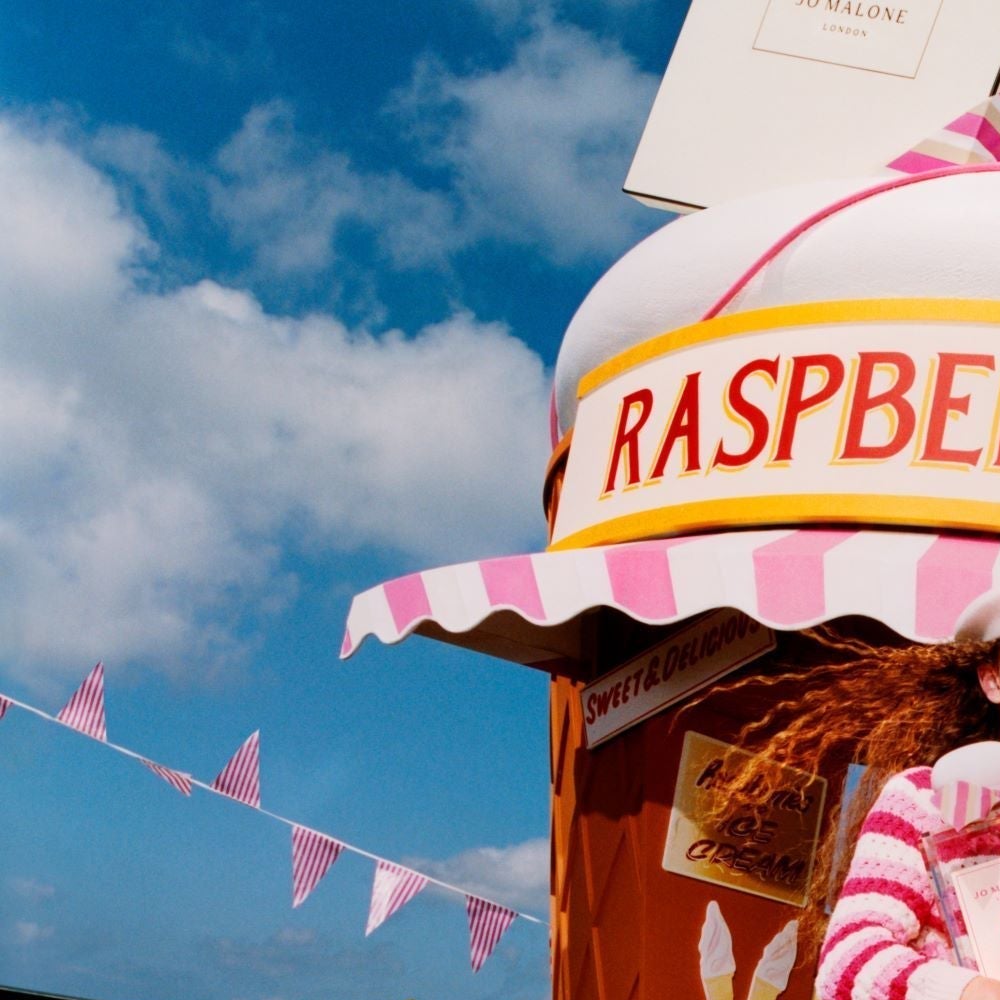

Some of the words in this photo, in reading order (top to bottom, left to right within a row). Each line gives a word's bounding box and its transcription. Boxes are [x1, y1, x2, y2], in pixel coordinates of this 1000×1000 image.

[825, 0, 908, 24] MALONE
[822, 23, 867, 37] LONDON
[974, 889, 988, 899] JO
